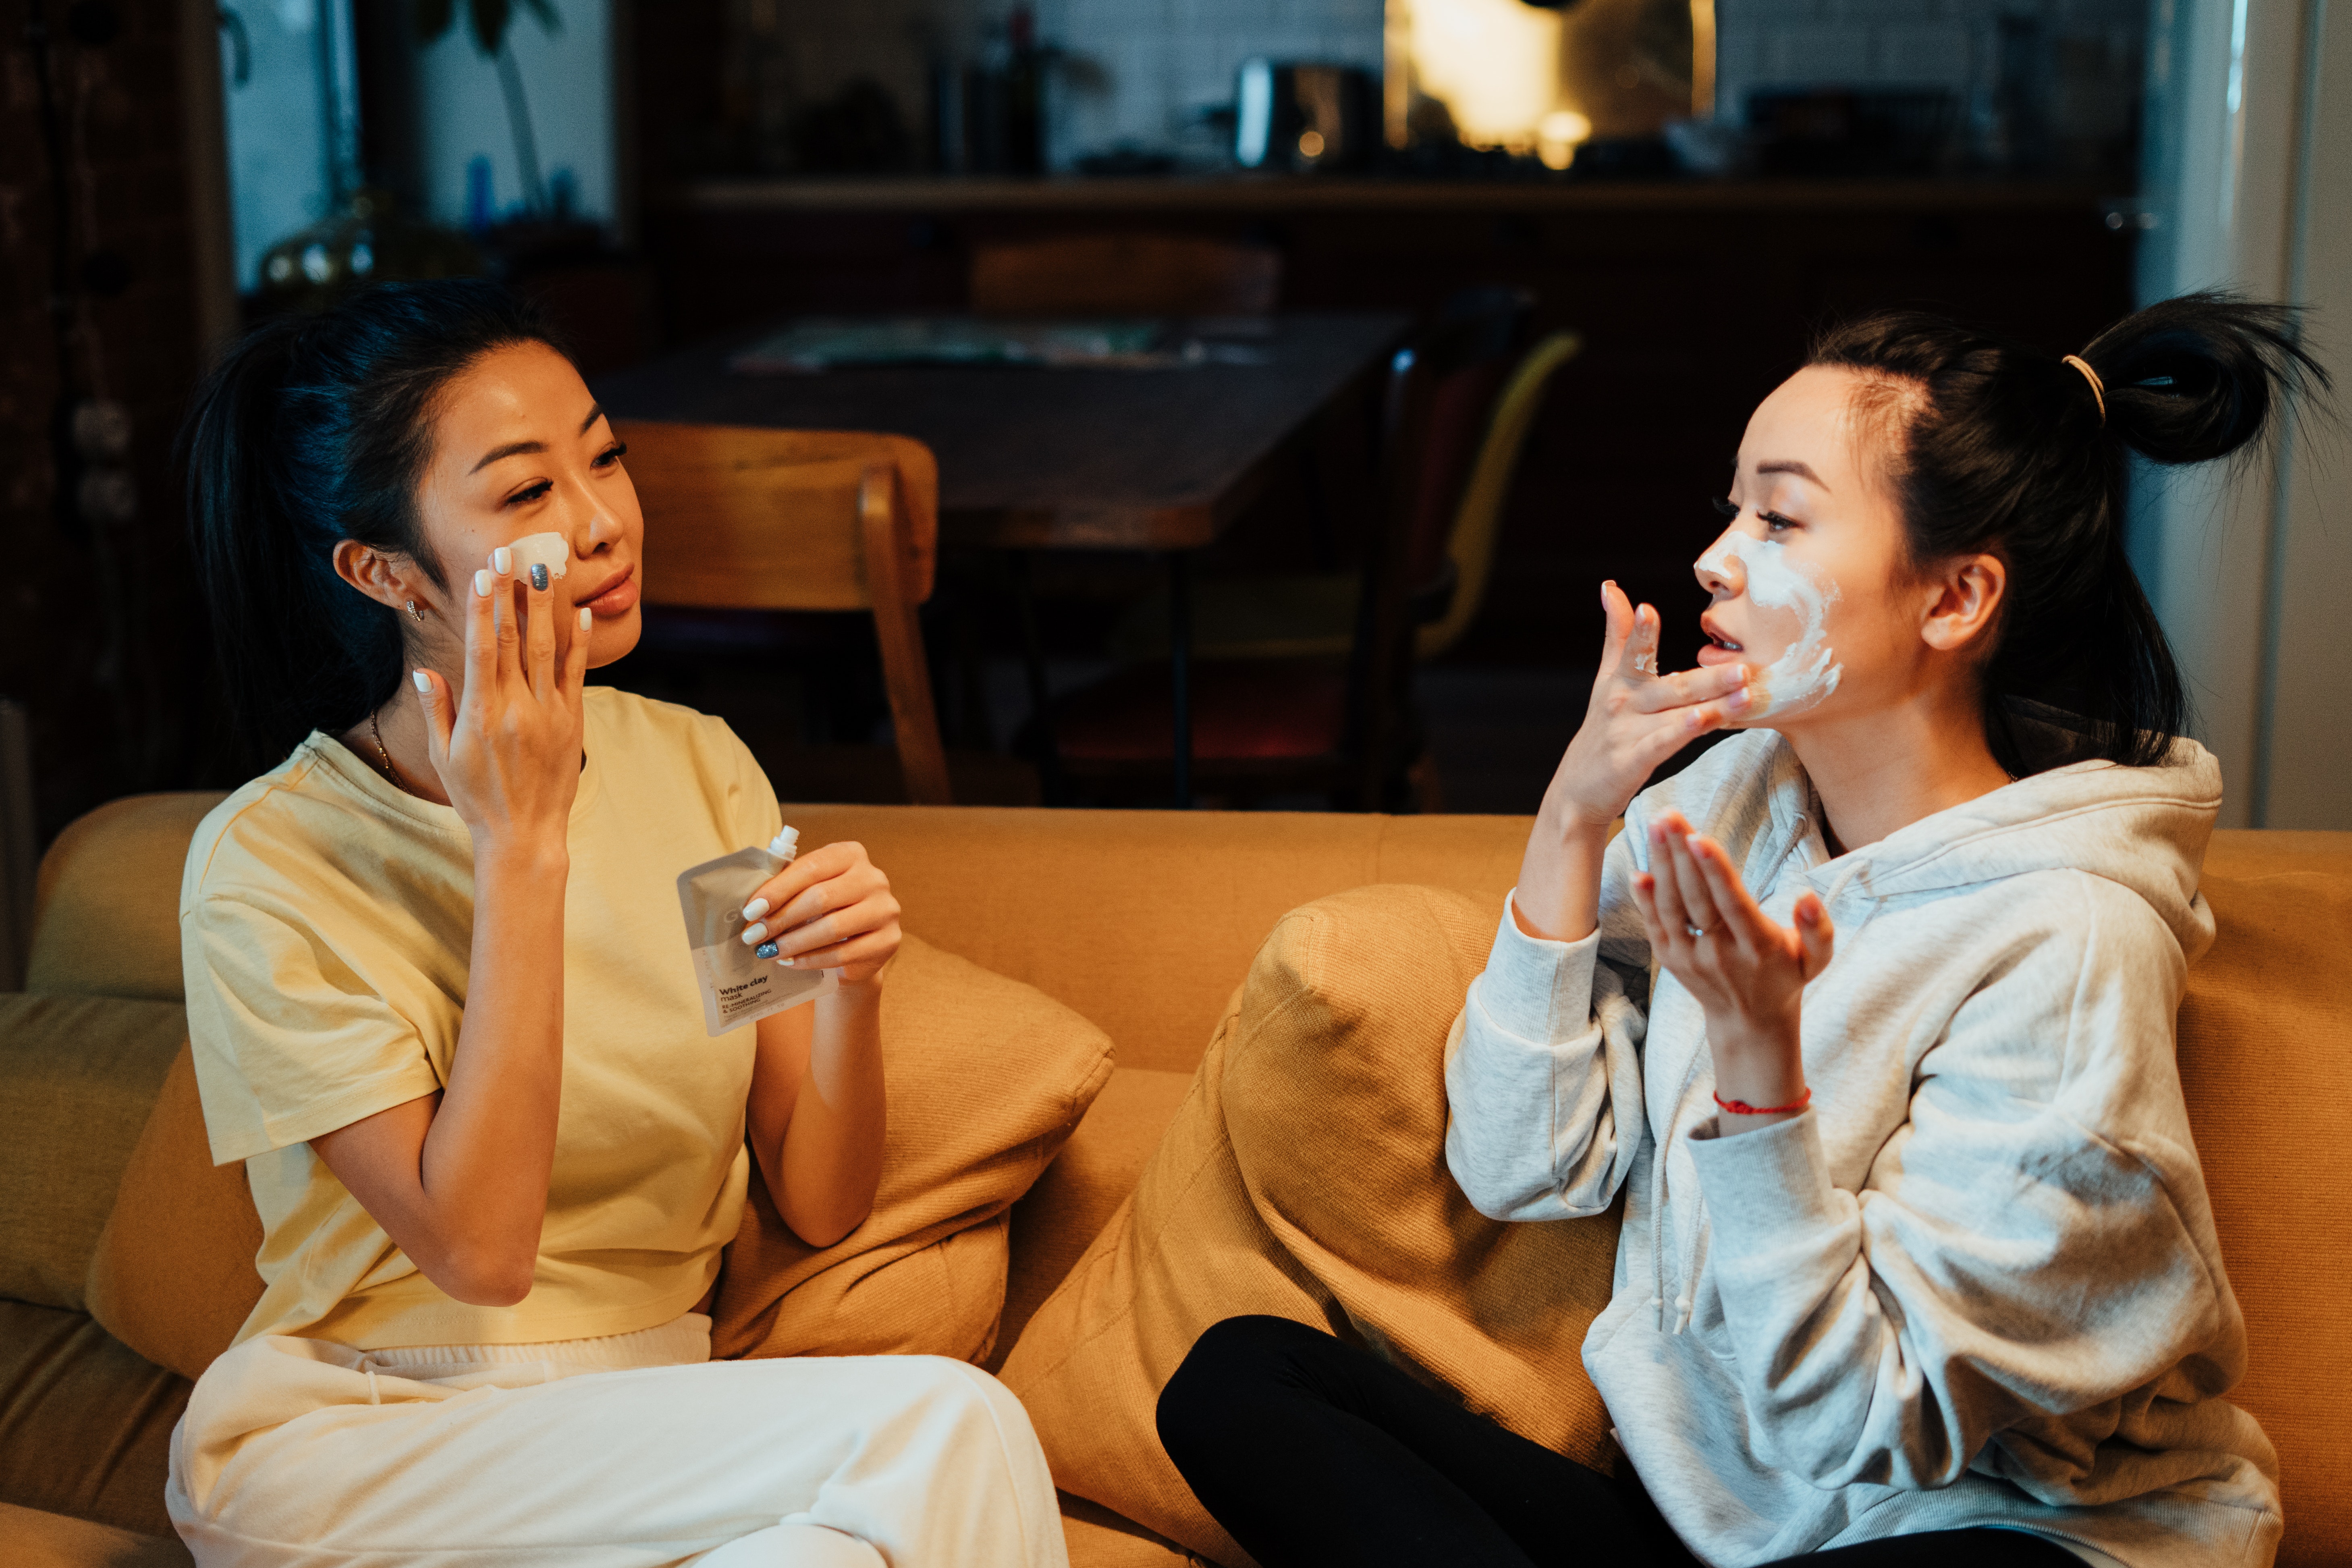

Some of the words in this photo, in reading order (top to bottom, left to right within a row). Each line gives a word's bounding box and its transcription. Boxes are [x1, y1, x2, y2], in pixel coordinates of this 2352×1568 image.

[719, 984, 748, 995] White
[750, 975, 768, 986] clay
[721, 992, 743, 1002] mask
[722, 989, 772, 1009] RE-MINERALIZING
[729, 998, 760, 1012] SOOTHING
